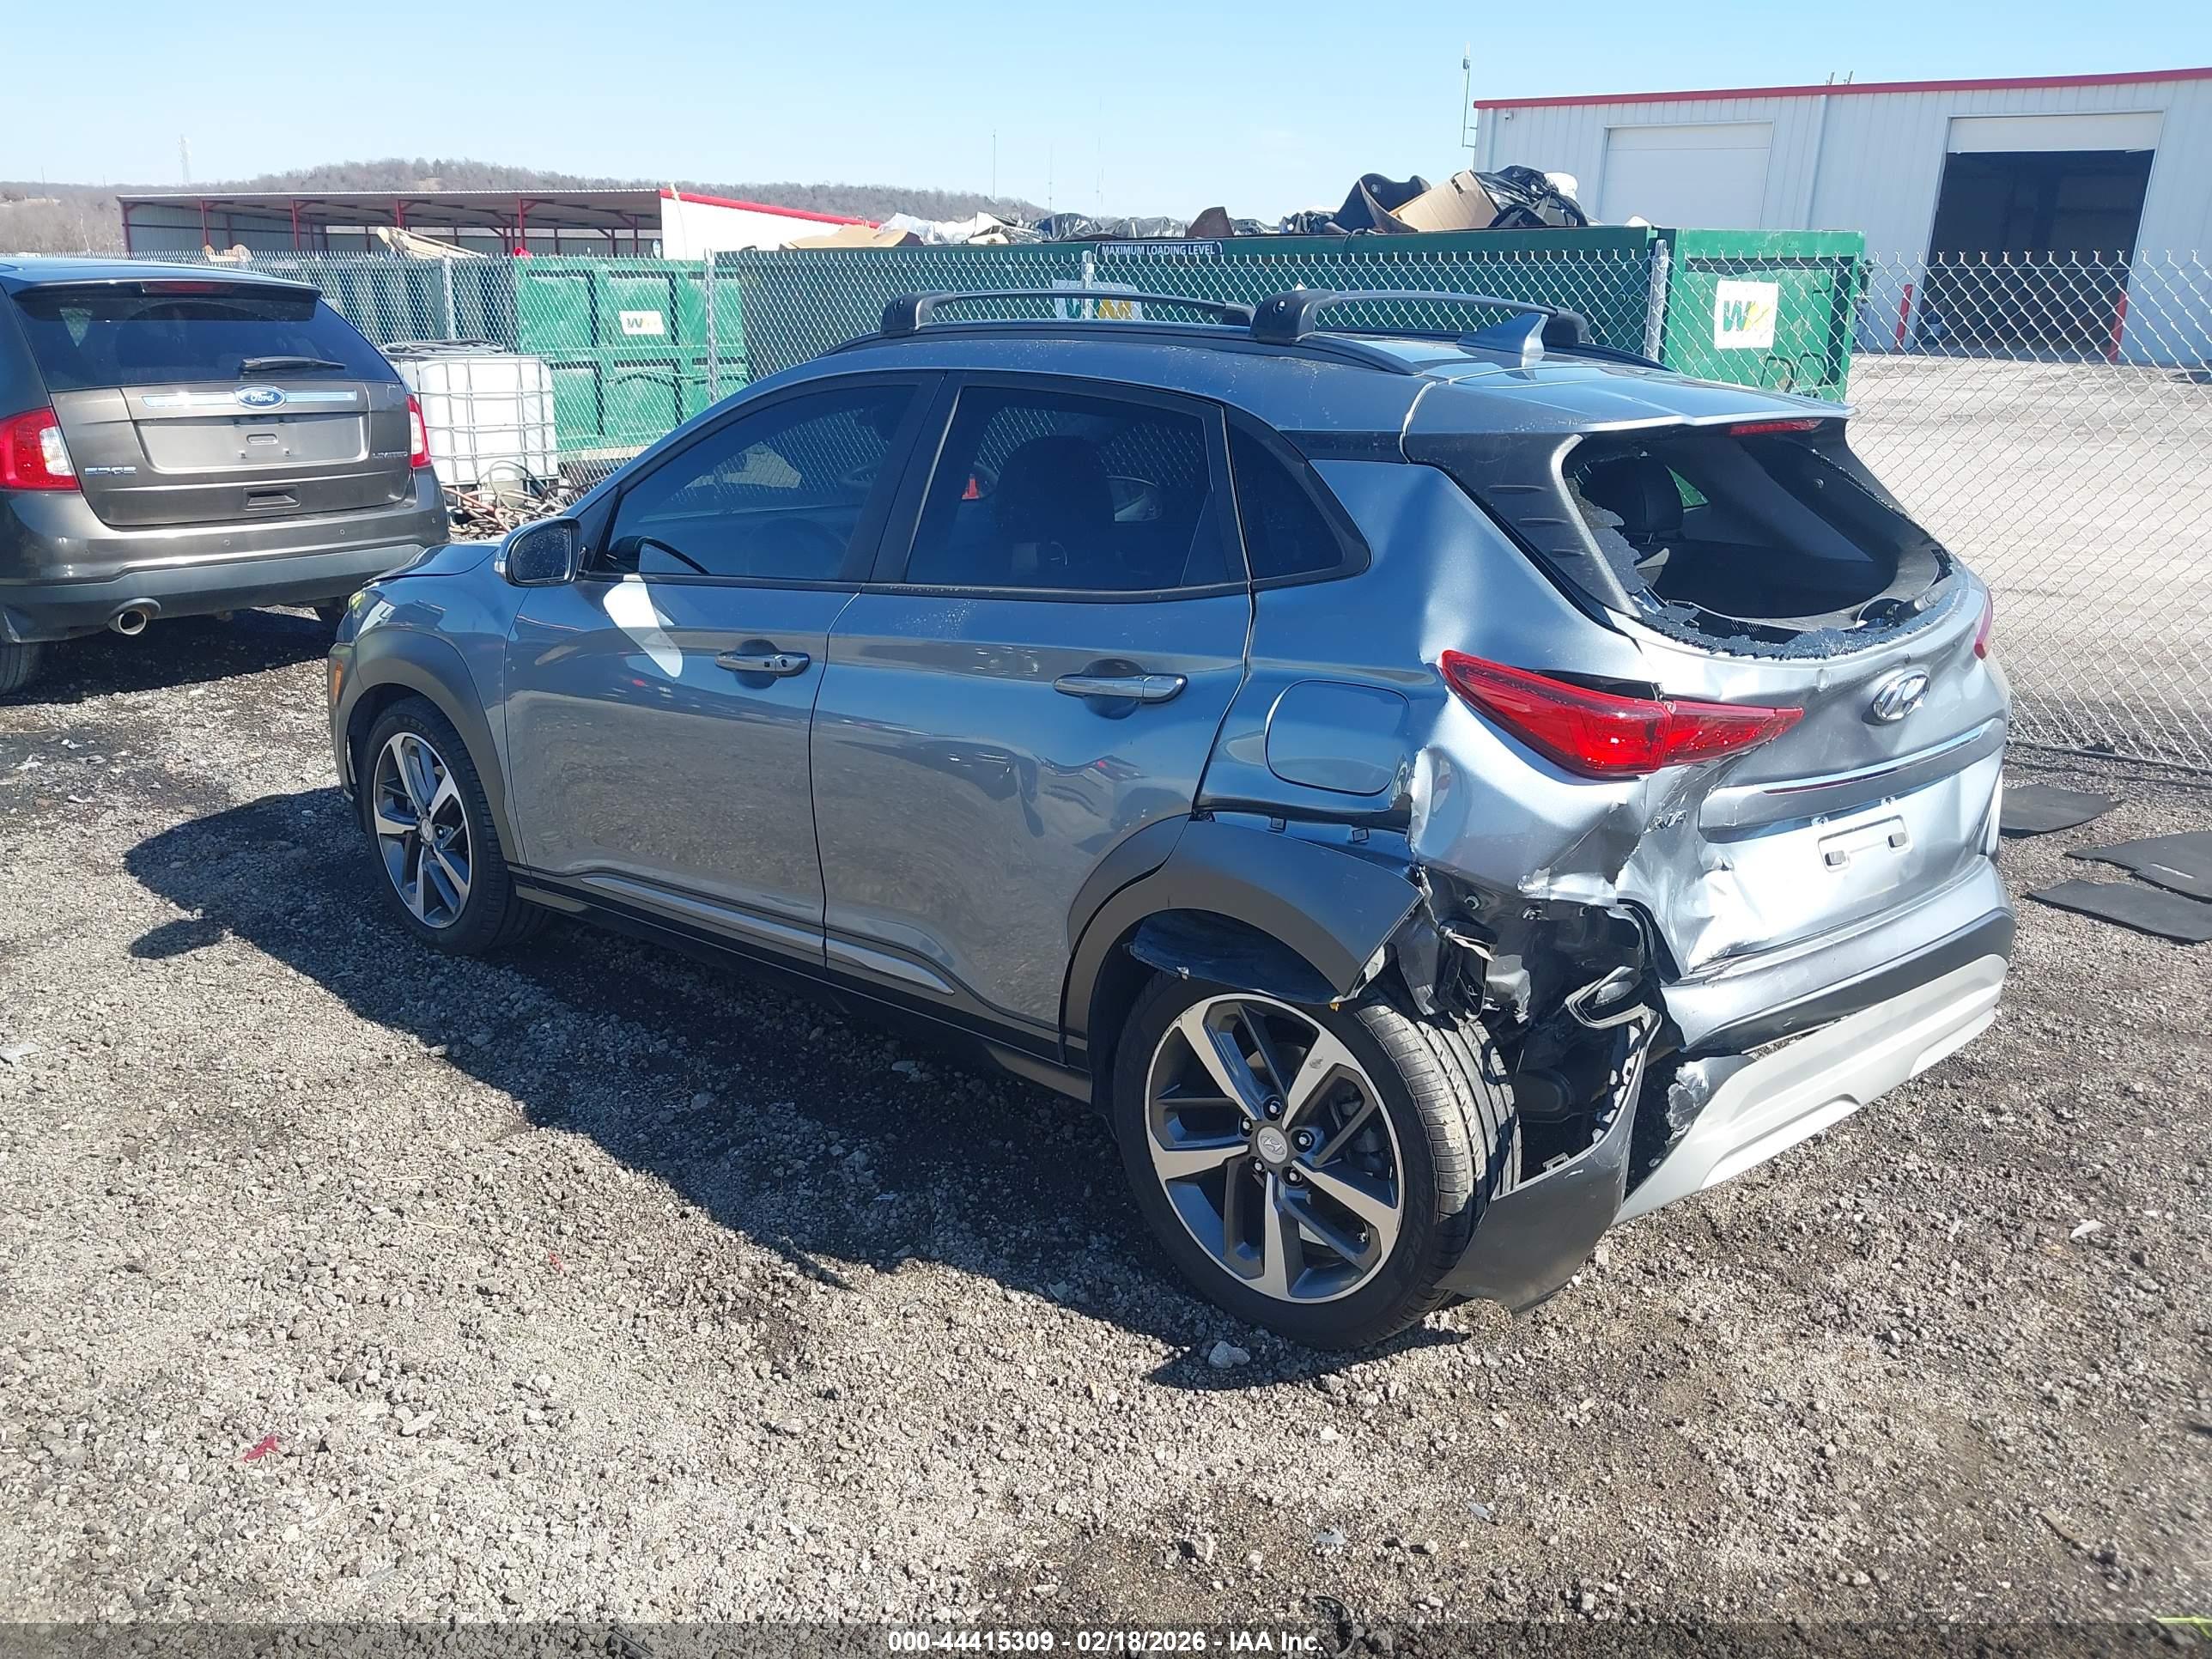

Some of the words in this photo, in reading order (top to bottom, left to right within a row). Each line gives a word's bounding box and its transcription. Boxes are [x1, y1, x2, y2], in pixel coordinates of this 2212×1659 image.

[1101, 245, 1145, 256] MAXIMUM
[1146, 244, 1187, 255] LOADING
[1188, 244, 1216, 255] LEVEL
[250, 391, 275, 403] Ford
